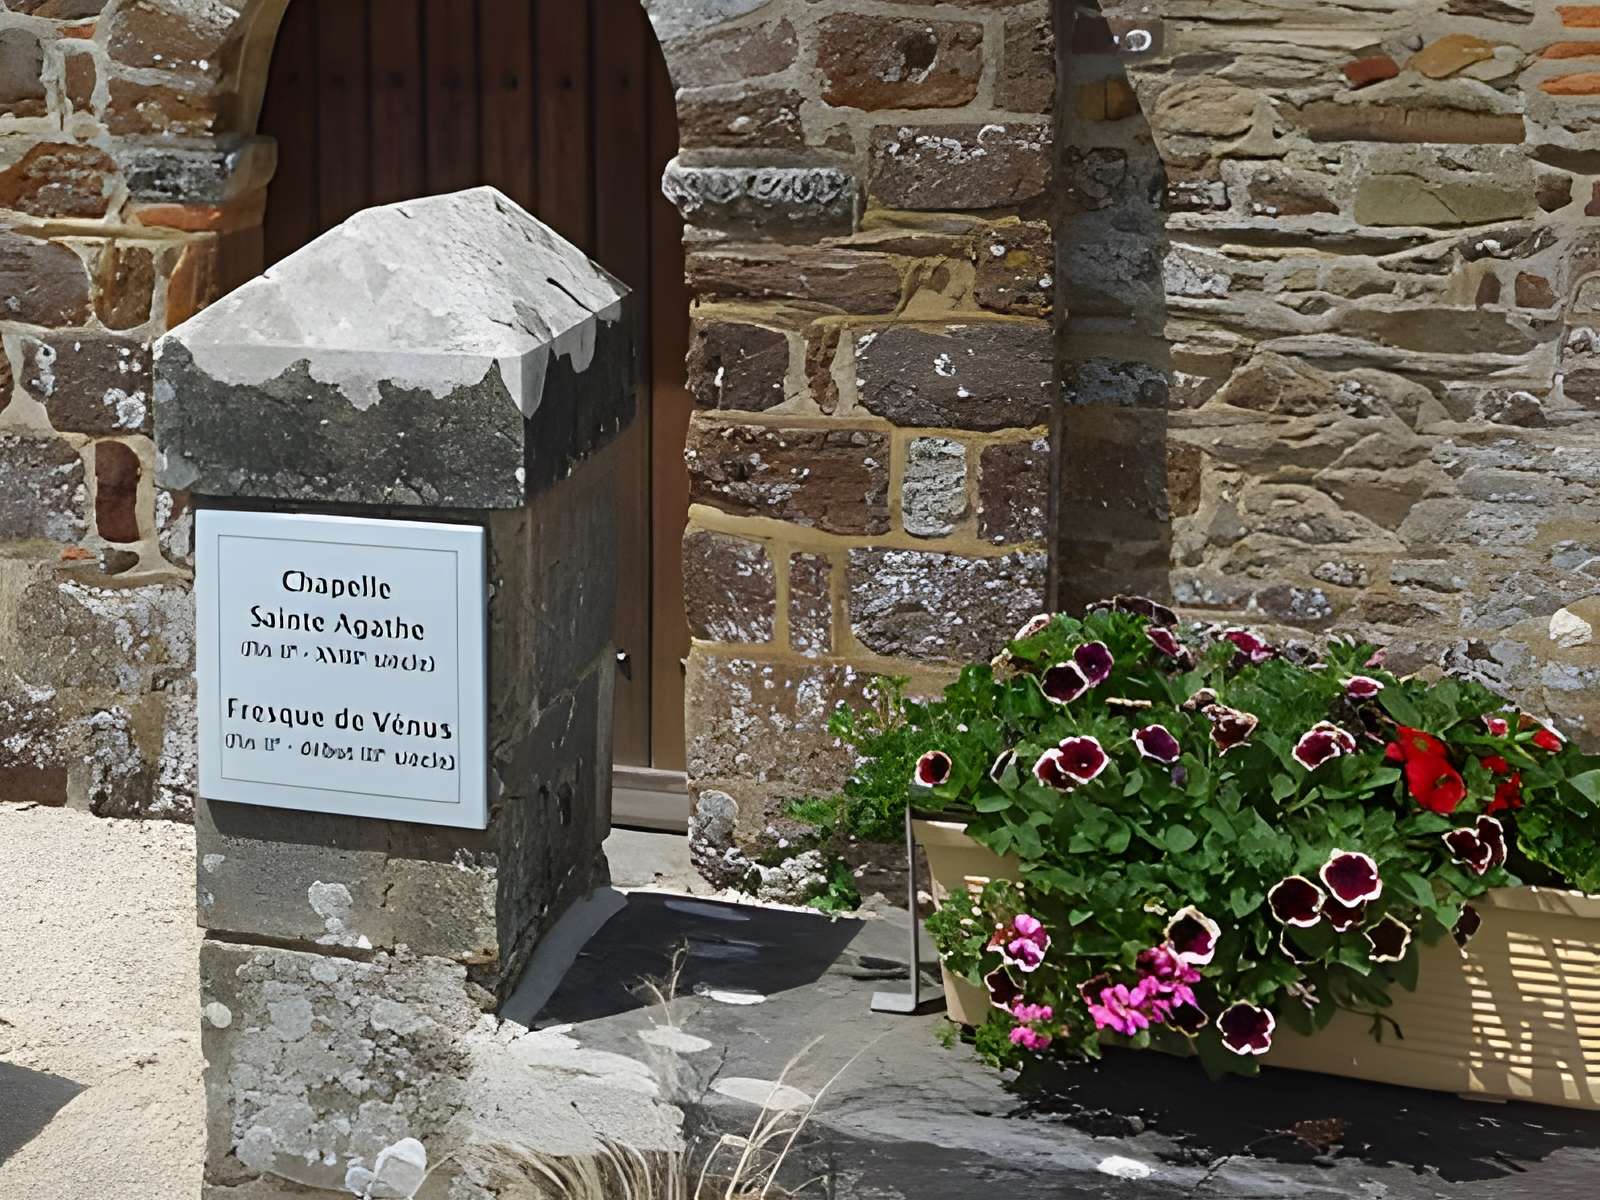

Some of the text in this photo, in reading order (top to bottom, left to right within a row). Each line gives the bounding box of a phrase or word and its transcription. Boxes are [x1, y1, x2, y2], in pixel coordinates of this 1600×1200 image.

[282, 569, 391, 600] Chapelle
[250, 604, 425, 641] Sainte Agathe
[226, 697, 452, 740] Fresque de Vénus
